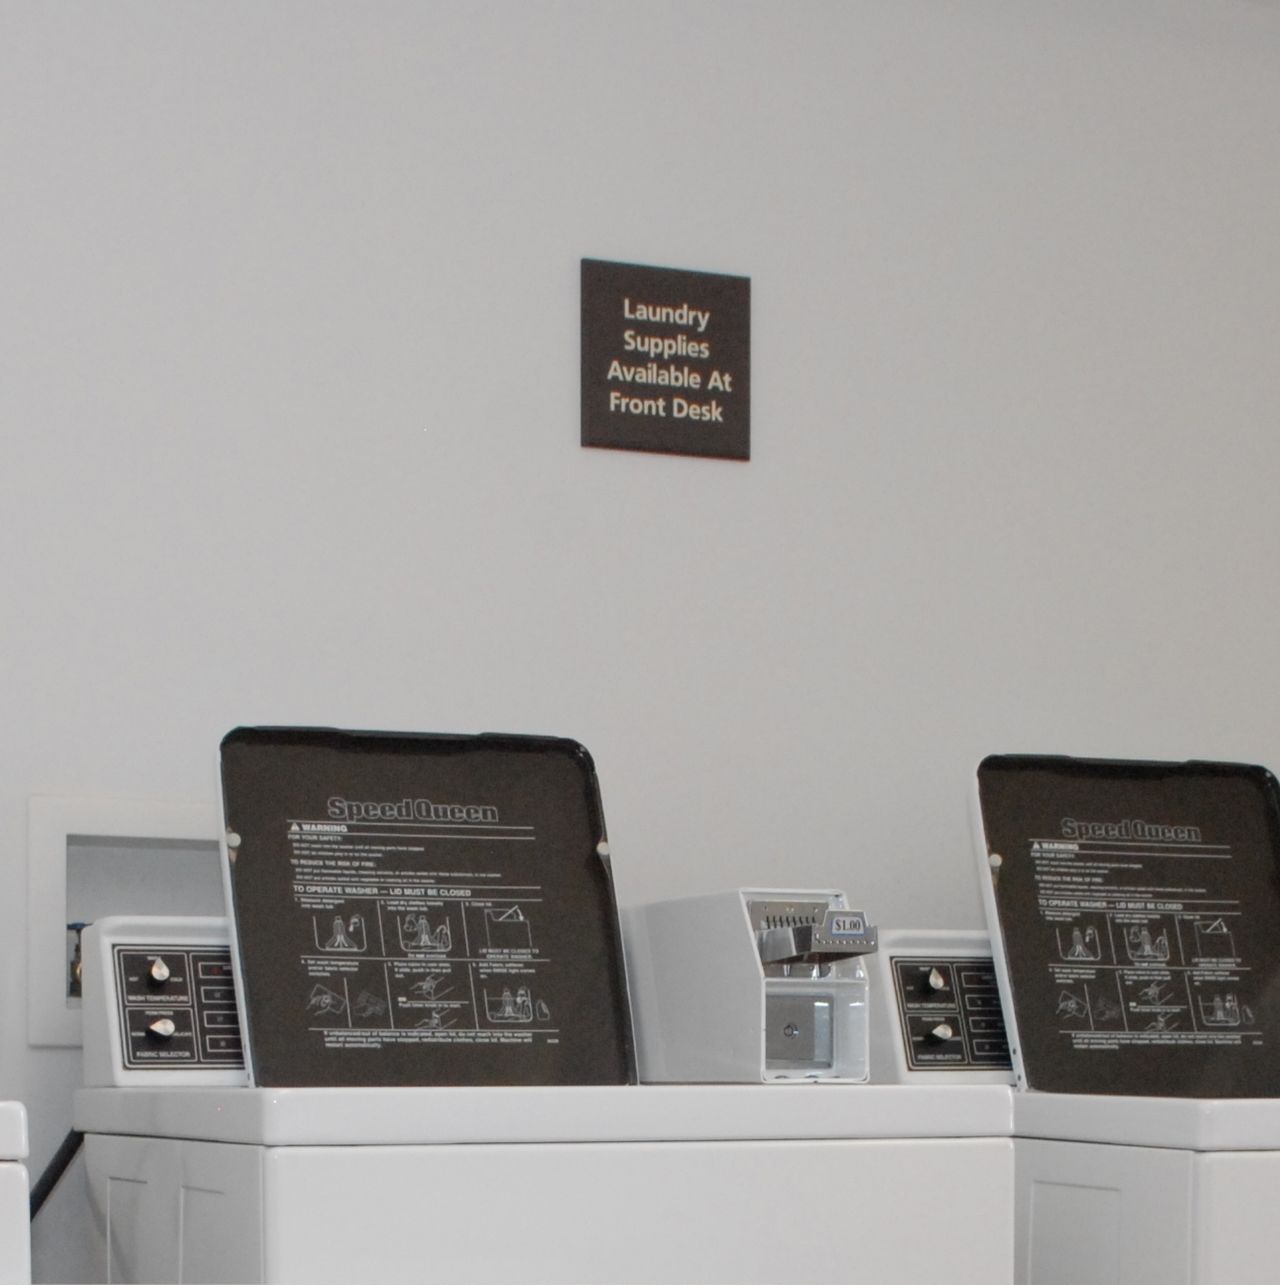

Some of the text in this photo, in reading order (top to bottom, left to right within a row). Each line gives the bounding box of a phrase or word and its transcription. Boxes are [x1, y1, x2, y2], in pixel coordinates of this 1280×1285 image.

[623, 298, 710, 332] Laundry
[623, 330, 710, 359] Supplies
[607, 360, 732, 392] Available At
[609, 392, 723, 423] Front Desk
[327, 797, 499, 822] Speed Queen
[302, 824, 348, 832] WARNING
[1061, 817, 1202, 842] Speed Queen
[306, 886, 343, 894] OPERATE
[344, 887, 378, 895] WASHER
[390, 888, 402, 896] LID
[404, 888, 426, 896] MUST
[427, 888, 438, 896] BE
[440, 889, 472, 897] CLOSED
[835, 919, 861, 931] $1.00
